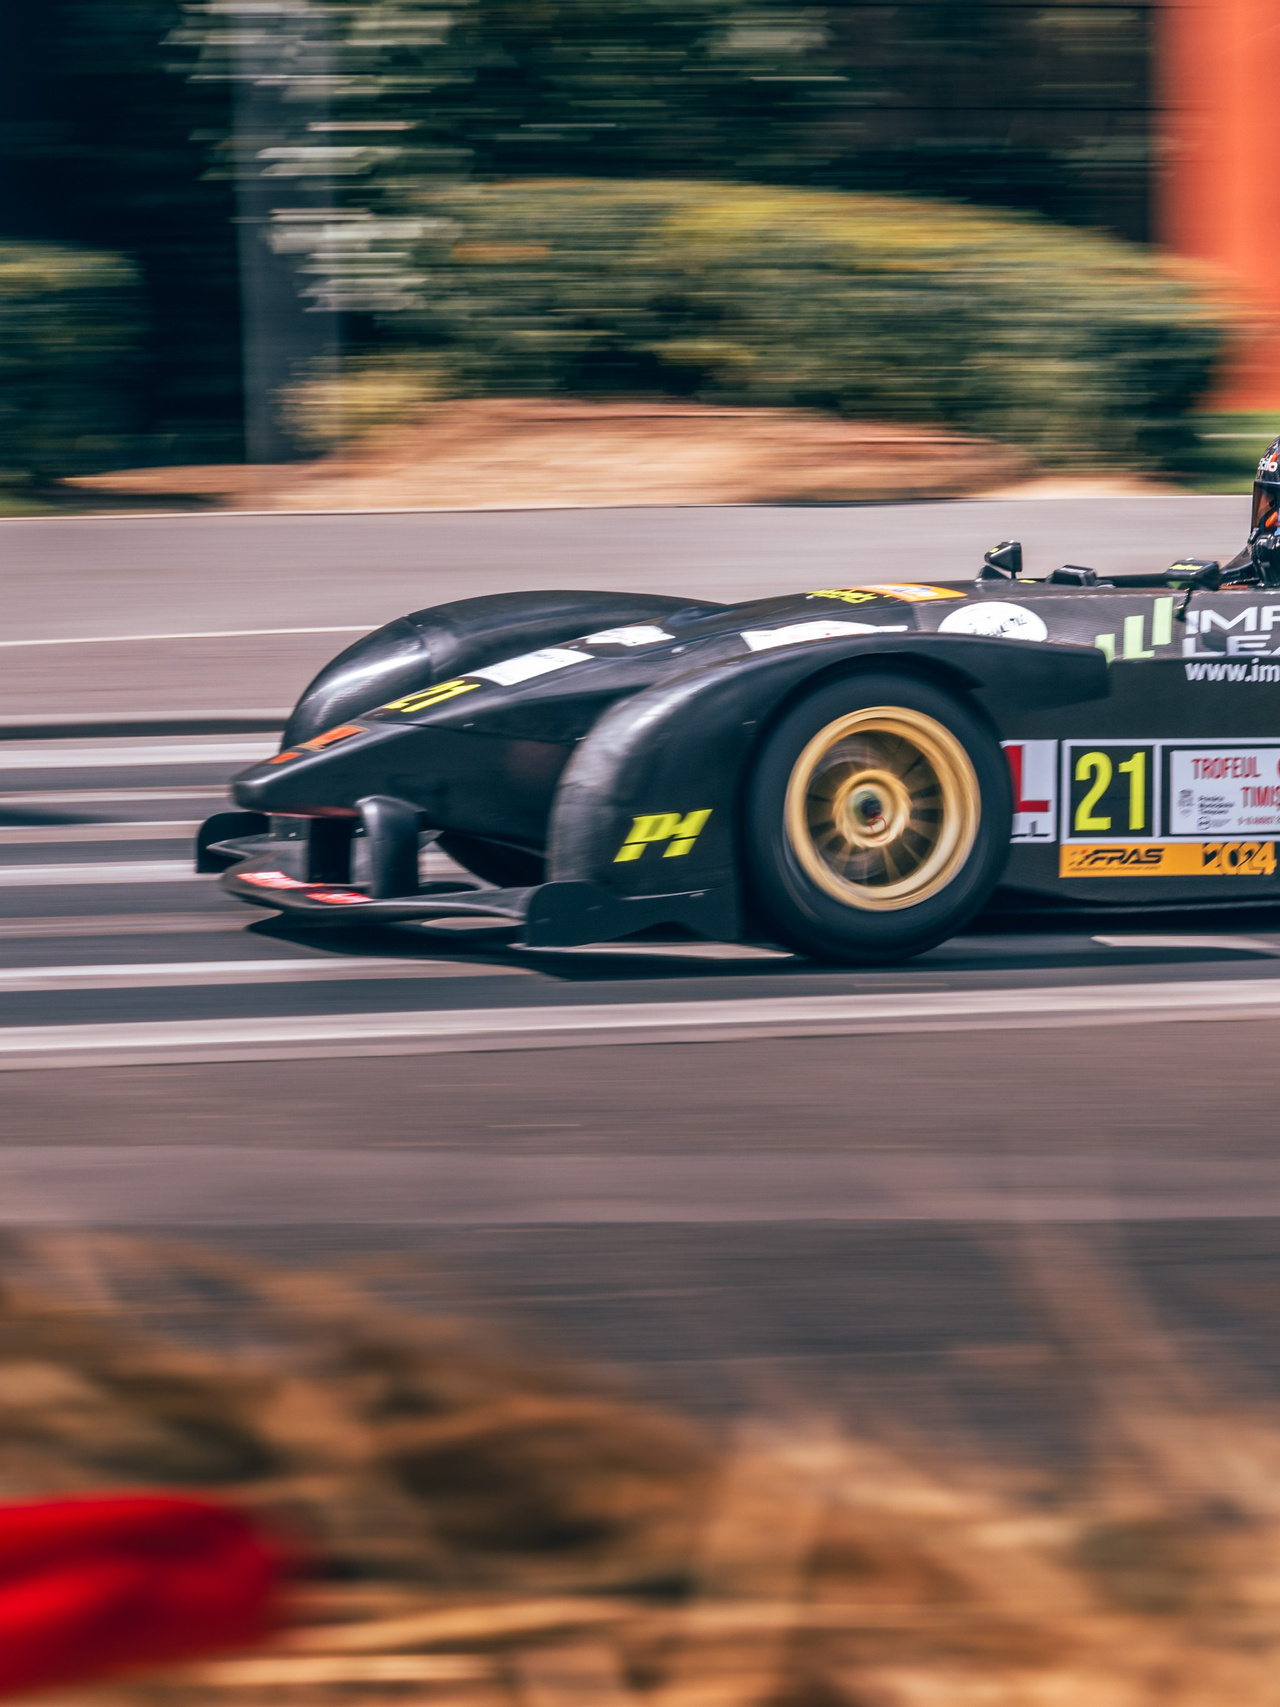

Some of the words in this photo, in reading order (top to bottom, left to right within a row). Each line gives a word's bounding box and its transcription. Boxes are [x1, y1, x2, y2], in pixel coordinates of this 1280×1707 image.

[1191, 756, 1261, 780] TROFEUL
[1074, 751, 1146, 831] 21
[1202, 841, 1277, 875] 2024
